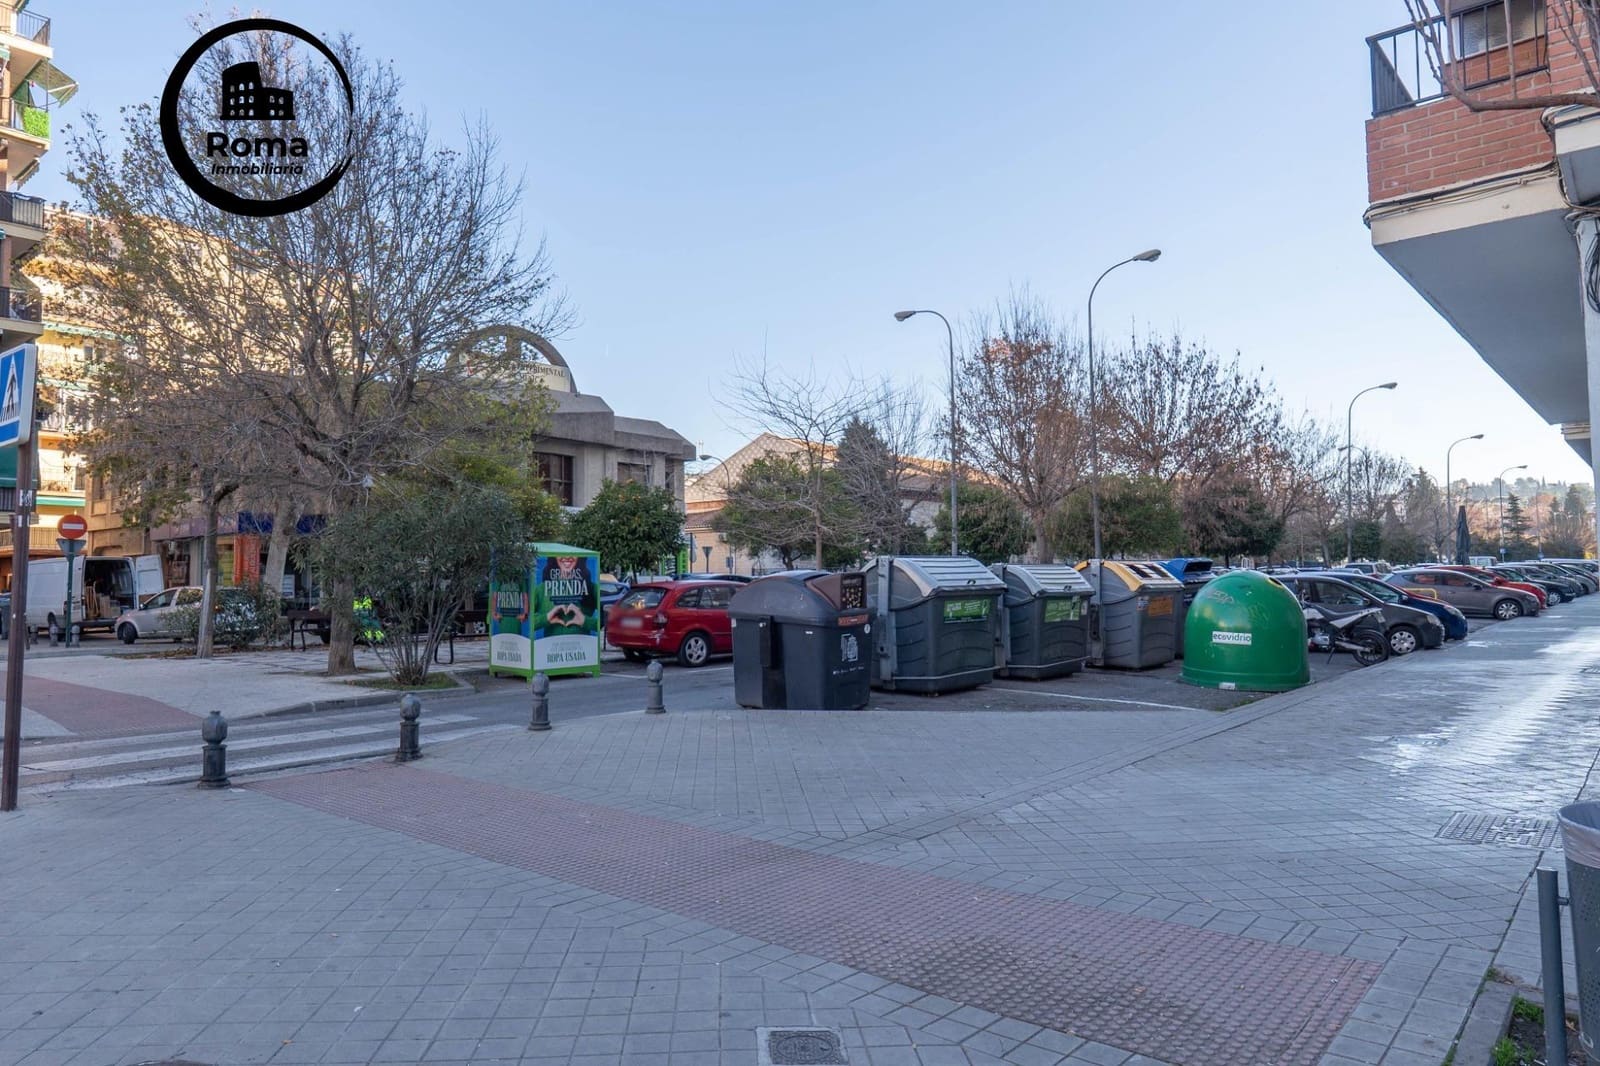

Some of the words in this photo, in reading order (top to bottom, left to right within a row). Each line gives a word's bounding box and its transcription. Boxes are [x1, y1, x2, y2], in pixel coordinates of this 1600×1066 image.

[544, 580, 589, 596] PRENDA
[497, 592, 524, 609] PRENDA
[1213, 633, 1252, 642] ecovidrio
[565, 651, 586, 662] USADA
